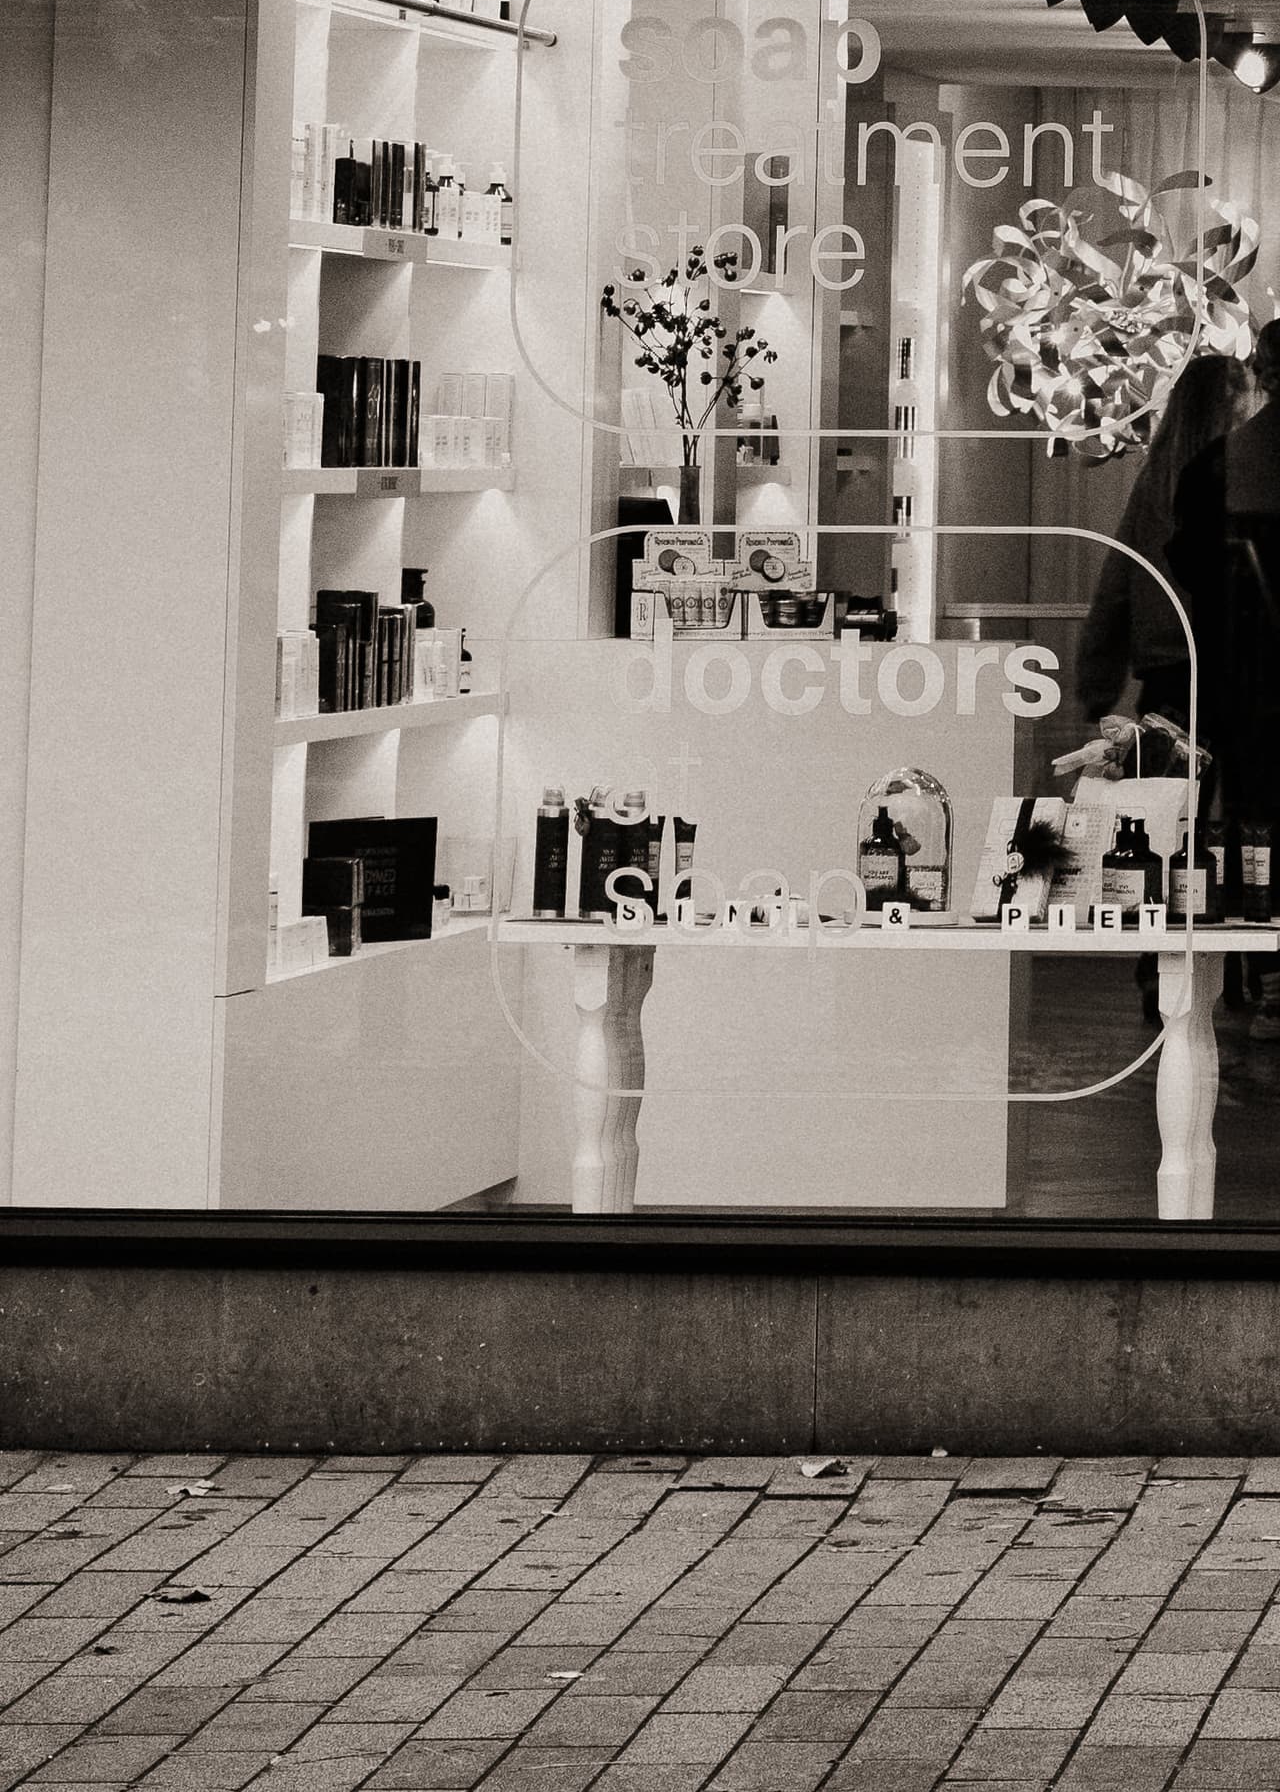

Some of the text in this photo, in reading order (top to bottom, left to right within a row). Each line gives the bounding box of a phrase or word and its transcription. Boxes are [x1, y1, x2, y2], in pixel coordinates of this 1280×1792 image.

[618, 16, 882, 100] soap
[614, 107, 1116, 189] treatment
[613, 214, 867, 292] store
[606, 629, 1062, 718] doctors
[602, 867, 868, 963] soap
[889, 907, 902, 924] &
[1008, 908, 1160, 929] PIET
